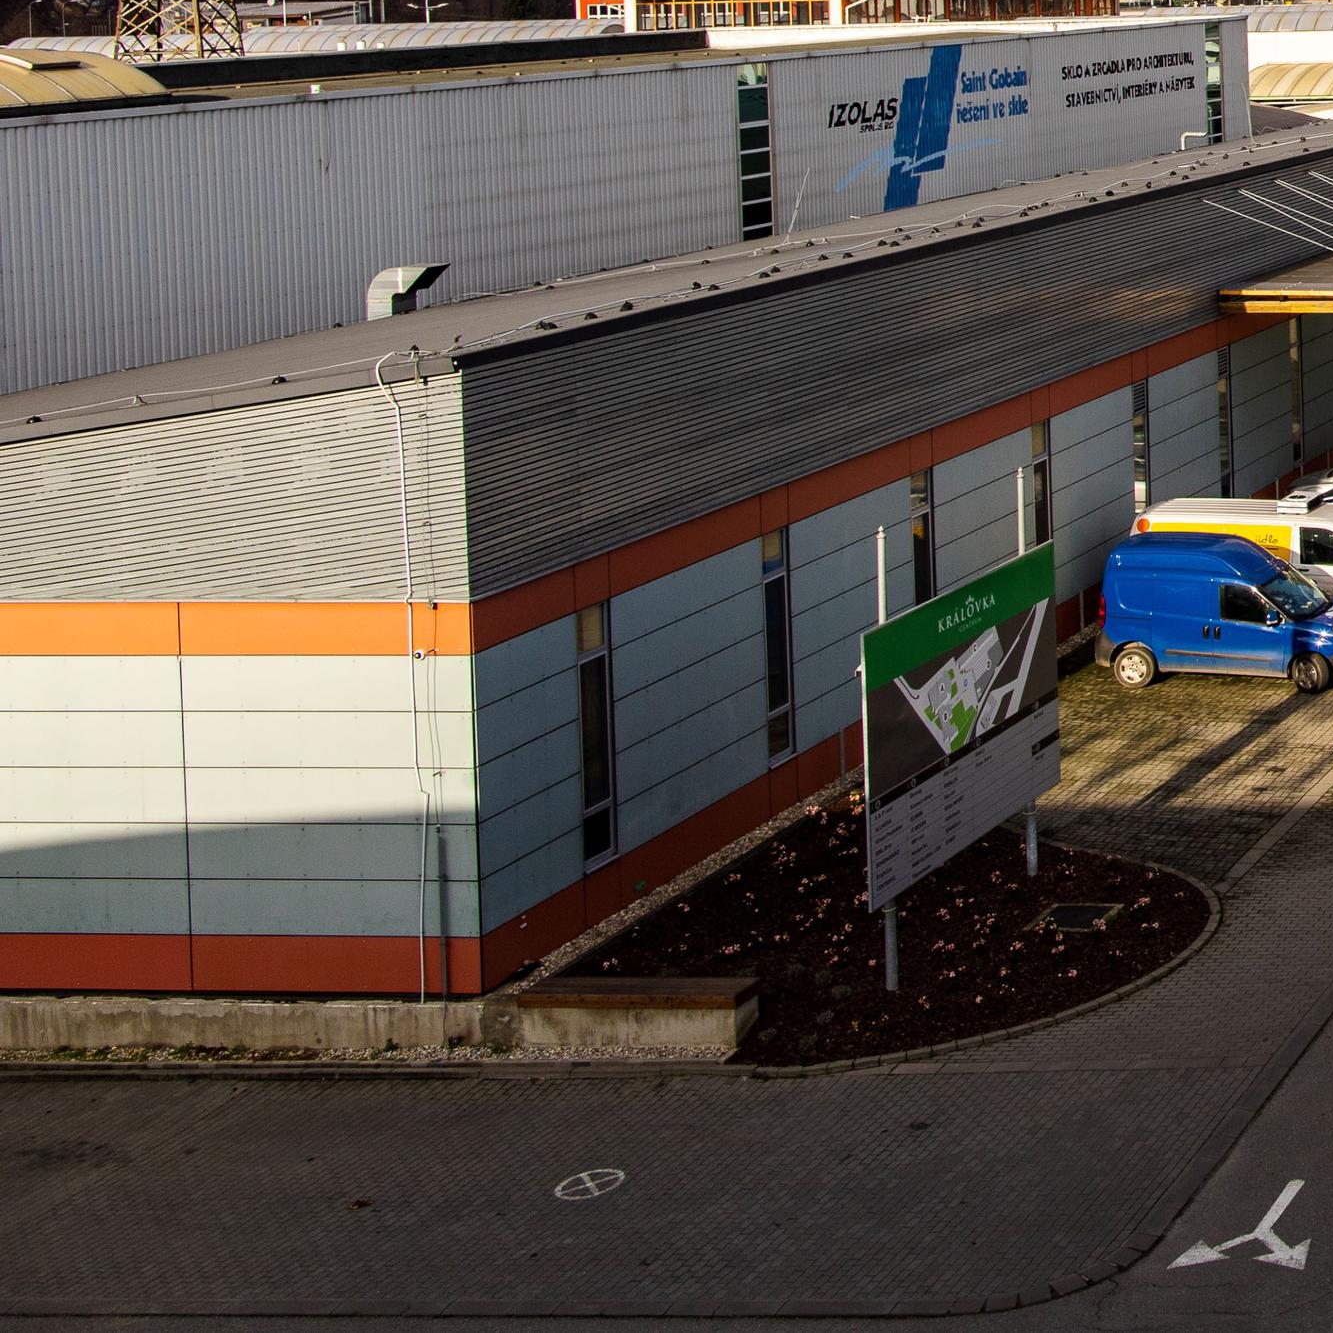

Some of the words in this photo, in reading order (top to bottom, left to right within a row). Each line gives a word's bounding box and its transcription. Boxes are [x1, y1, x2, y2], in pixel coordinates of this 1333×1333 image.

[961, 71, 986, 94] Saint
[989, 66, 1027, 90] Gobain
[1062, 65, 1082, 80] SKLO
[1084, 66, 1091, 78] A
[1092, 59, 1126, 76] ZRCADLA
[1127, 57, 1141, 72] PRO
[1144, 52, 1194, 69] ARCHITEKTURU,
[1066, 84, 1121, 108] STAVEBNICTVÍ,
[1123, 79, 1158, 100] INTERIÉRY
[1159, 82, 1165, 93] A
[1165, 75, 1195, 93] NÁBYTEK
[828, 98, 898, 128] IZOLAS
[993, 102, 1005, 118] ve
[1009, 95, 1029, 116] skle
[938, 594, 995, 633] KRÁLOVKA
